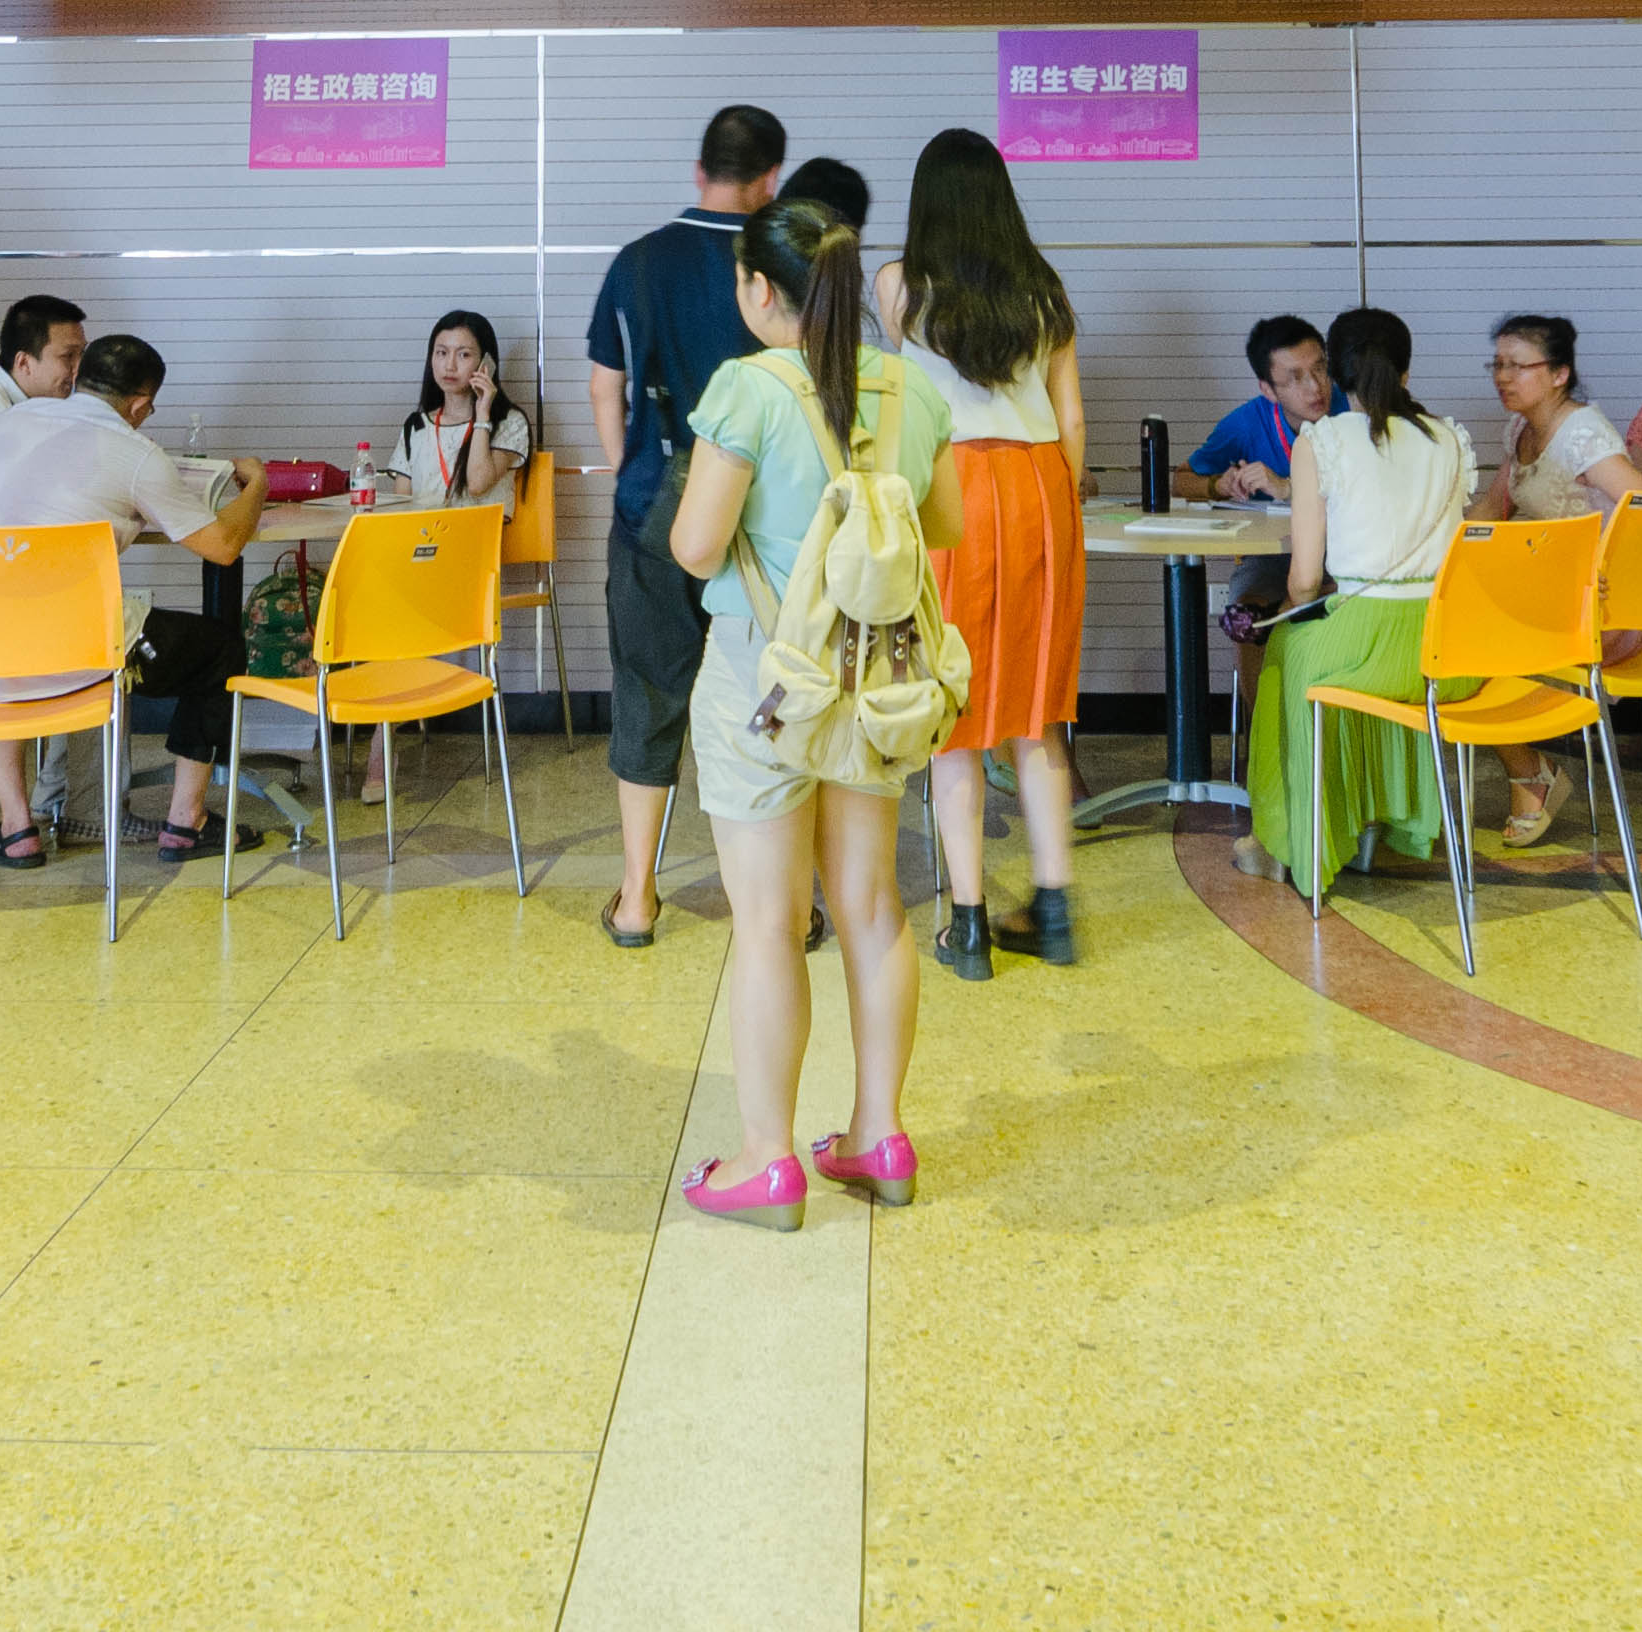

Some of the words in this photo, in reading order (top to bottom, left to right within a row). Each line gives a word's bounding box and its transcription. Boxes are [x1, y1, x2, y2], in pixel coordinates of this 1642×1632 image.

[263, 72, 438, 102] 招生政策咨询
[1009, 63, 1188, 94] 招生专业咨询
